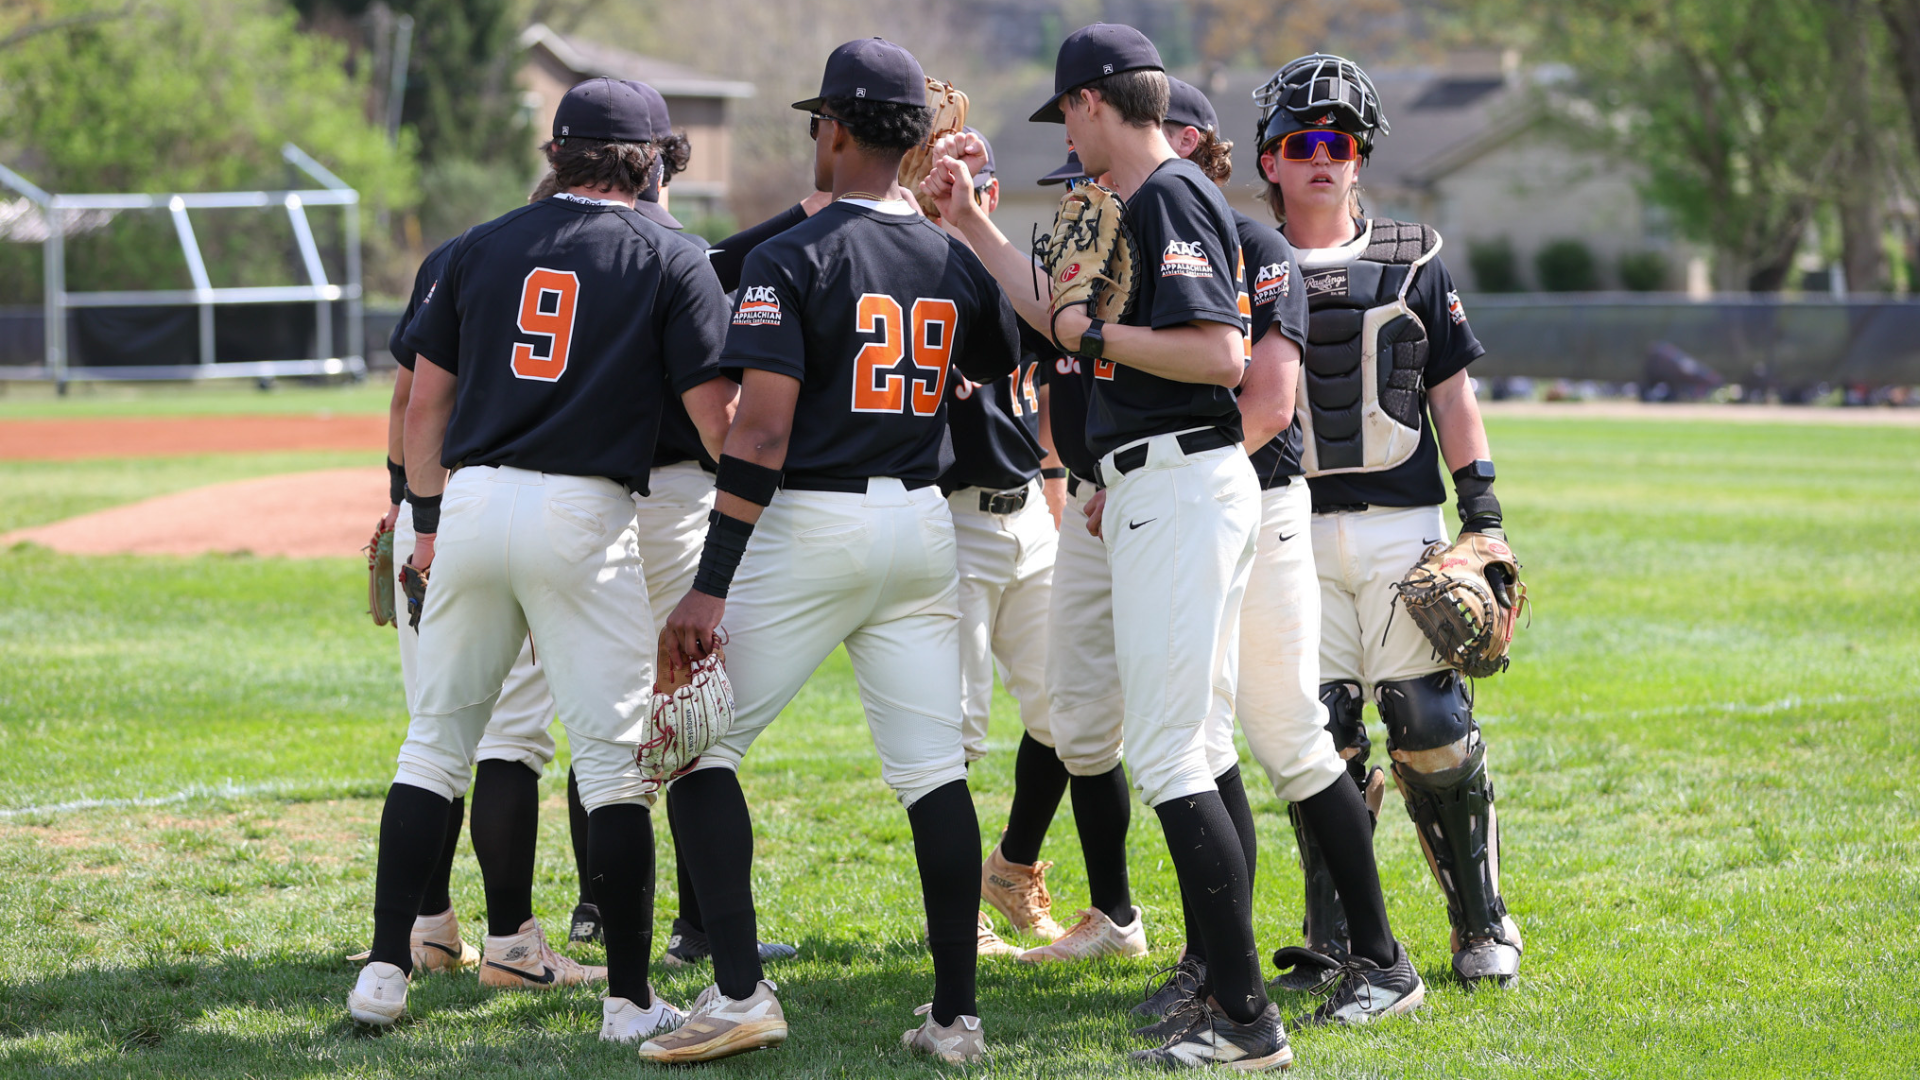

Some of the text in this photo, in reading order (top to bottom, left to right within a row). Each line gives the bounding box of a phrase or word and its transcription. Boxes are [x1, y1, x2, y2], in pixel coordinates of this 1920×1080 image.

[1168, 240, 1202, 257] AAC
[1160, 263, 1213, 273] APPALACHIAN
[1305, 274, 1346, 290] Rawlings
[744, 285, 775, 303] AAC
[733, 311, 782, 320] APPALACHIAN
[510, 267, 580, 382] 9
[851, 293, 958, 417] 29
